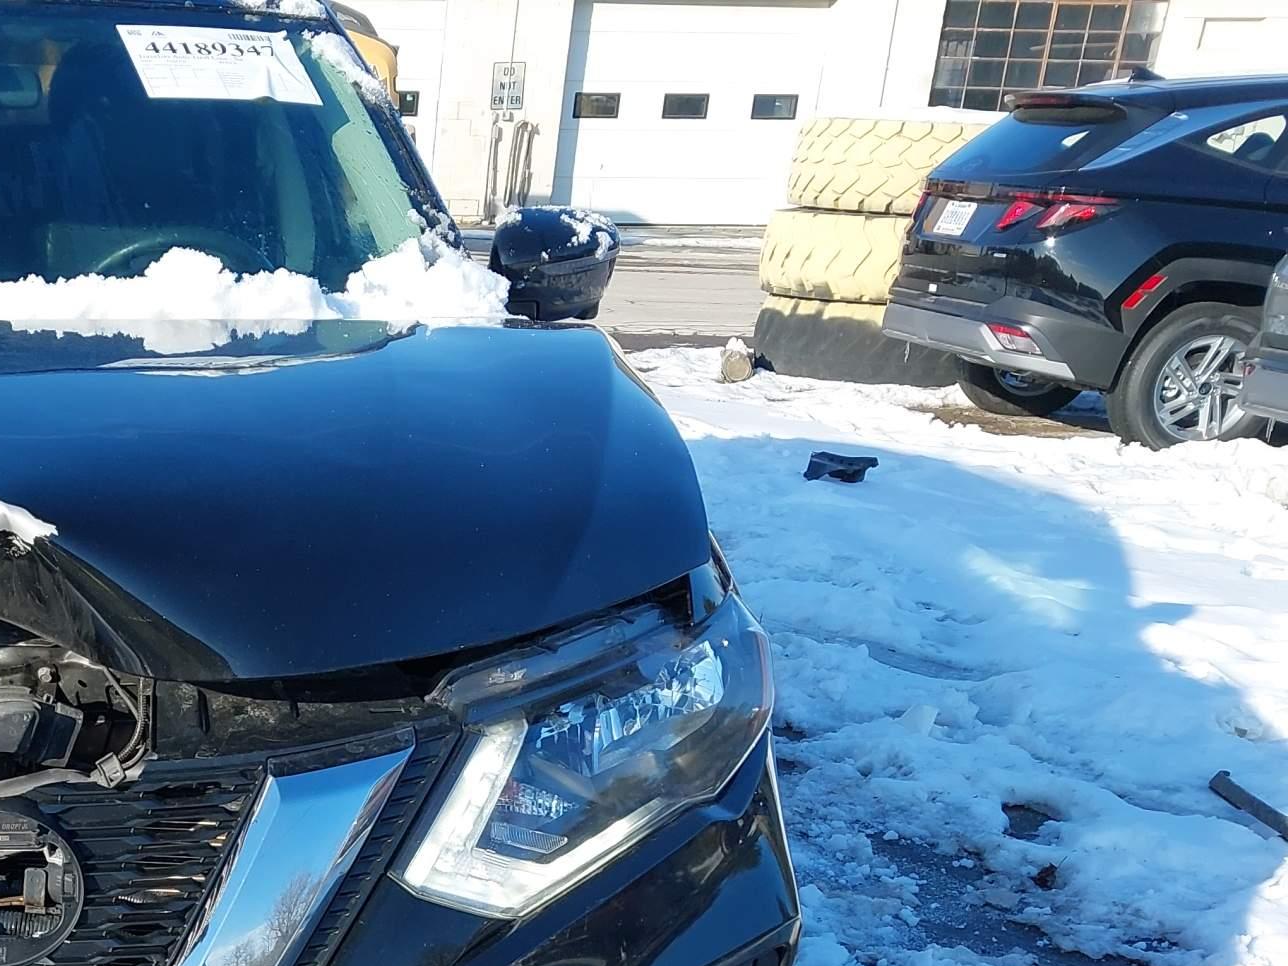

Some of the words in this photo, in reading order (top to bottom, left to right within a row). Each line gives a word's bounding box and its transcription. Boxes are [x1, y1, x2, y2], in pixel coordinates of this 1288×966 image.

[145, 41, 275, 57] 44189347
[503, 67, 516, 76] DO
[493, 95, 521, 105] ENER
